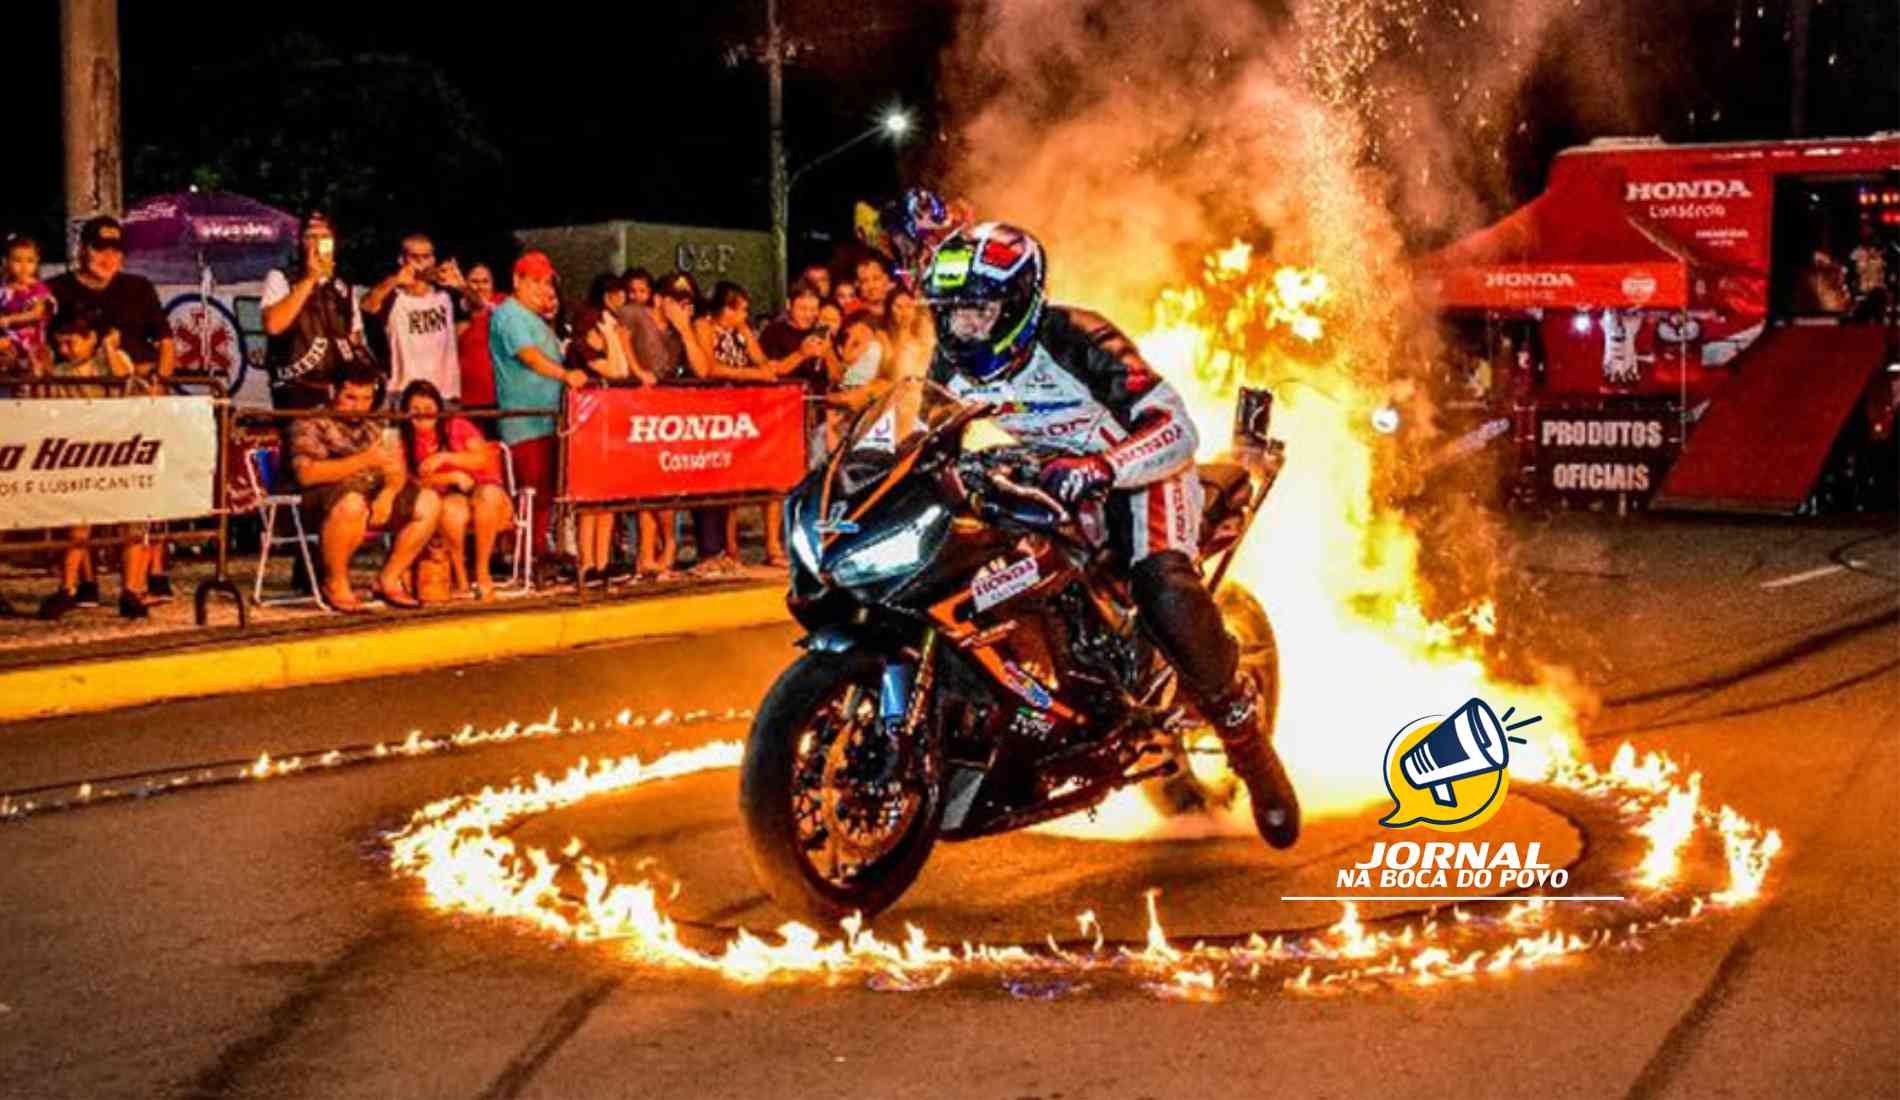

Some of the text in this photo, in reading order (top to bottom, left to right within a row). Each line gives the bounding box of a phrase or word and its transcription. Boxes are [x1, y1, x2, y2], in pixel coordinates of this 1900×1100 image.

[1626, 179, 1753, 201] HONDA
[1485, 272, 1575, 287] HONDA
[627, 411, 761, 443] HONDA
[1541, 419, 1664, 448] PRODUTOS
[31, 432, 163, 471] Honda
[1553, 463, 1650, 491] OFICIAIS
